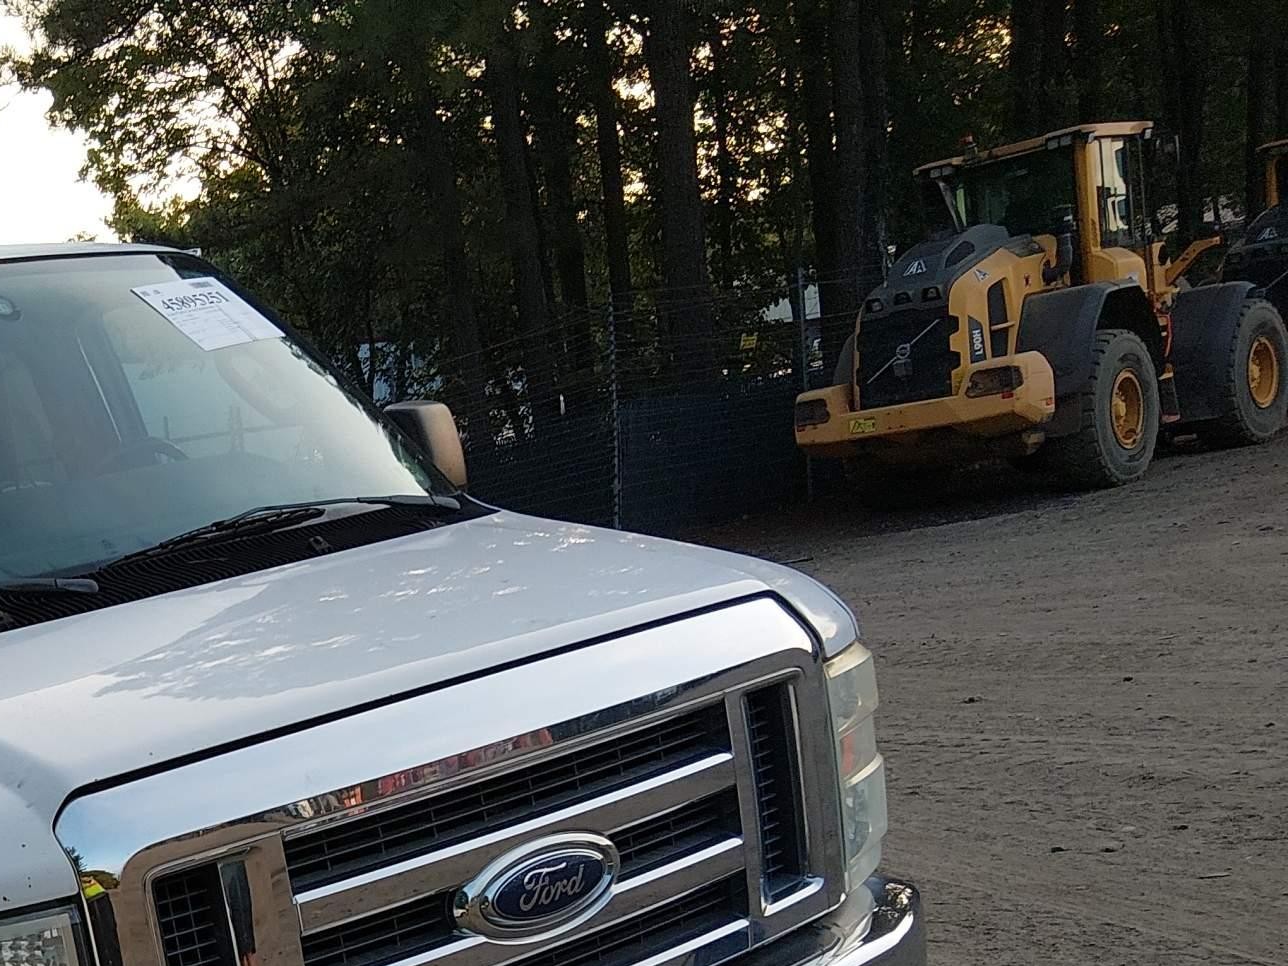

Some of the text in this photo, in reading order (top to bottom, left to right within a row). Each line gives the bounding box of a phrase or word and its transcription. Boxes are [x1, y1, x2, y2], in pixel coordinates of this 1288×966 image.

[161, 291, 230, 312] 45895251
[972, 328, 984, 356] L90H
[519, 861, 585, 912] Ford
